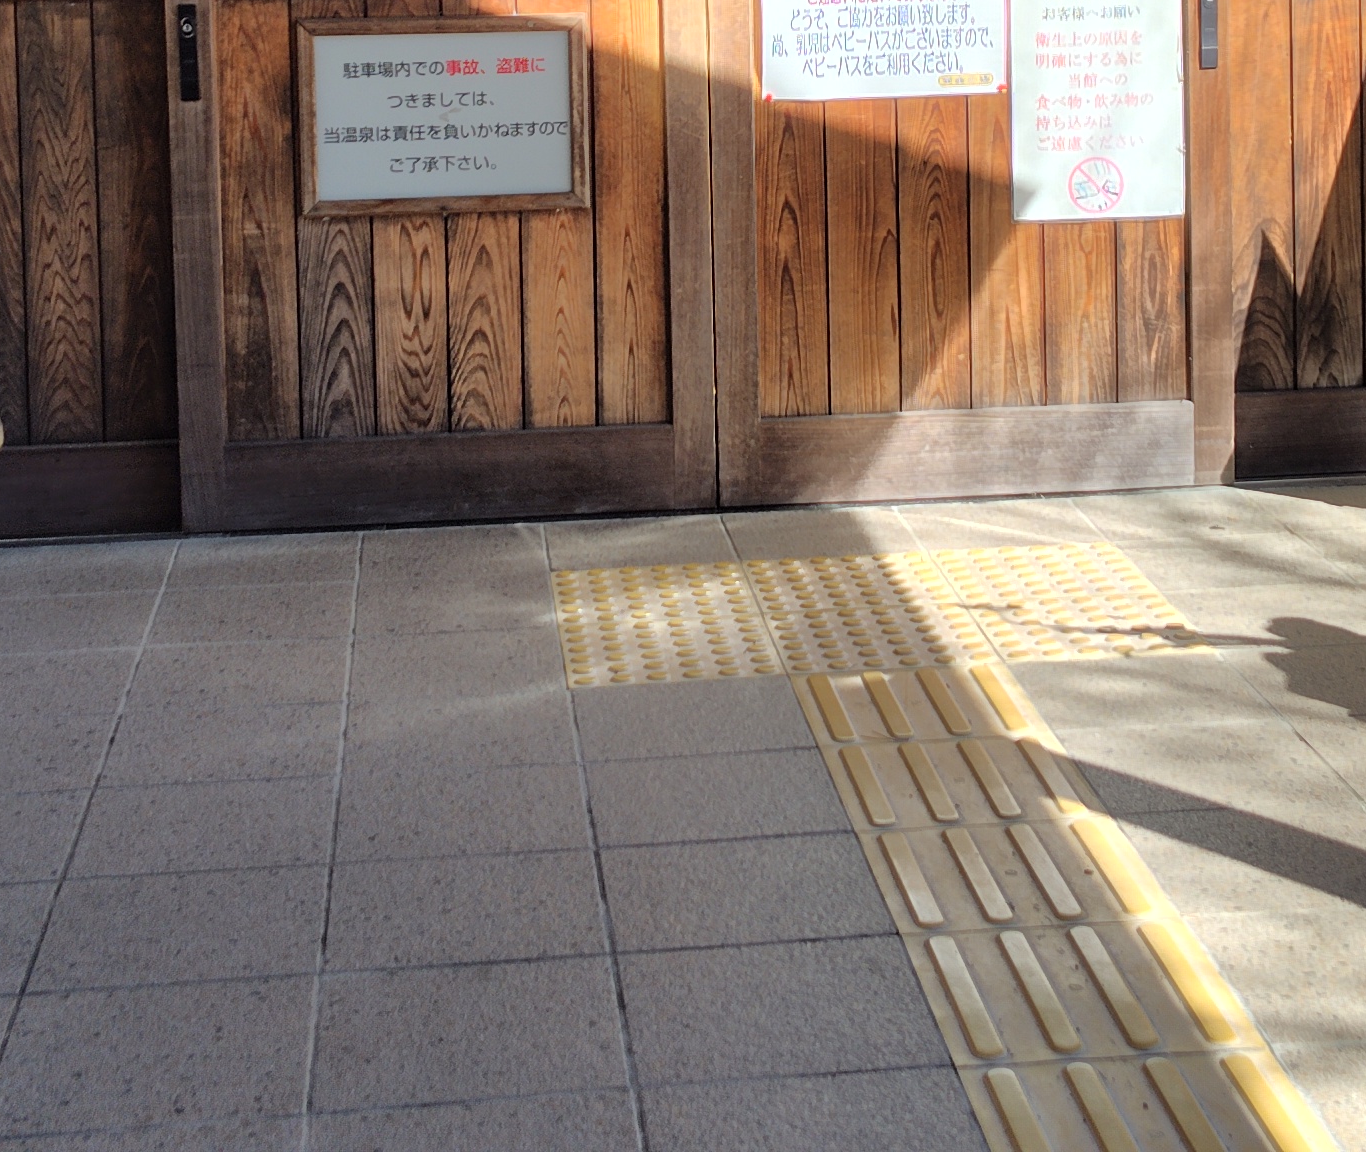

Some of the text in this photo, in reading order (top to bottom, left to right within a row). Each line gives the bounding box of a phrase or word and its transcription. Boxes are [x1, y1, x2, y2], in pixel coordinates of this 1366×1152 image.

[1041, 4, 1142, 21] お客様へお願い
[342, 56, 546, 80] 駐車場内での事故、盗難に
[387, 90, 495, 109] つきましては、
[1035, 112, 1113, 132] 持ち込みは
[323, 120, 570, 145] 当温泉は責任を負いかねますので
[389, 155, 498, 174] ご了承下さい。
